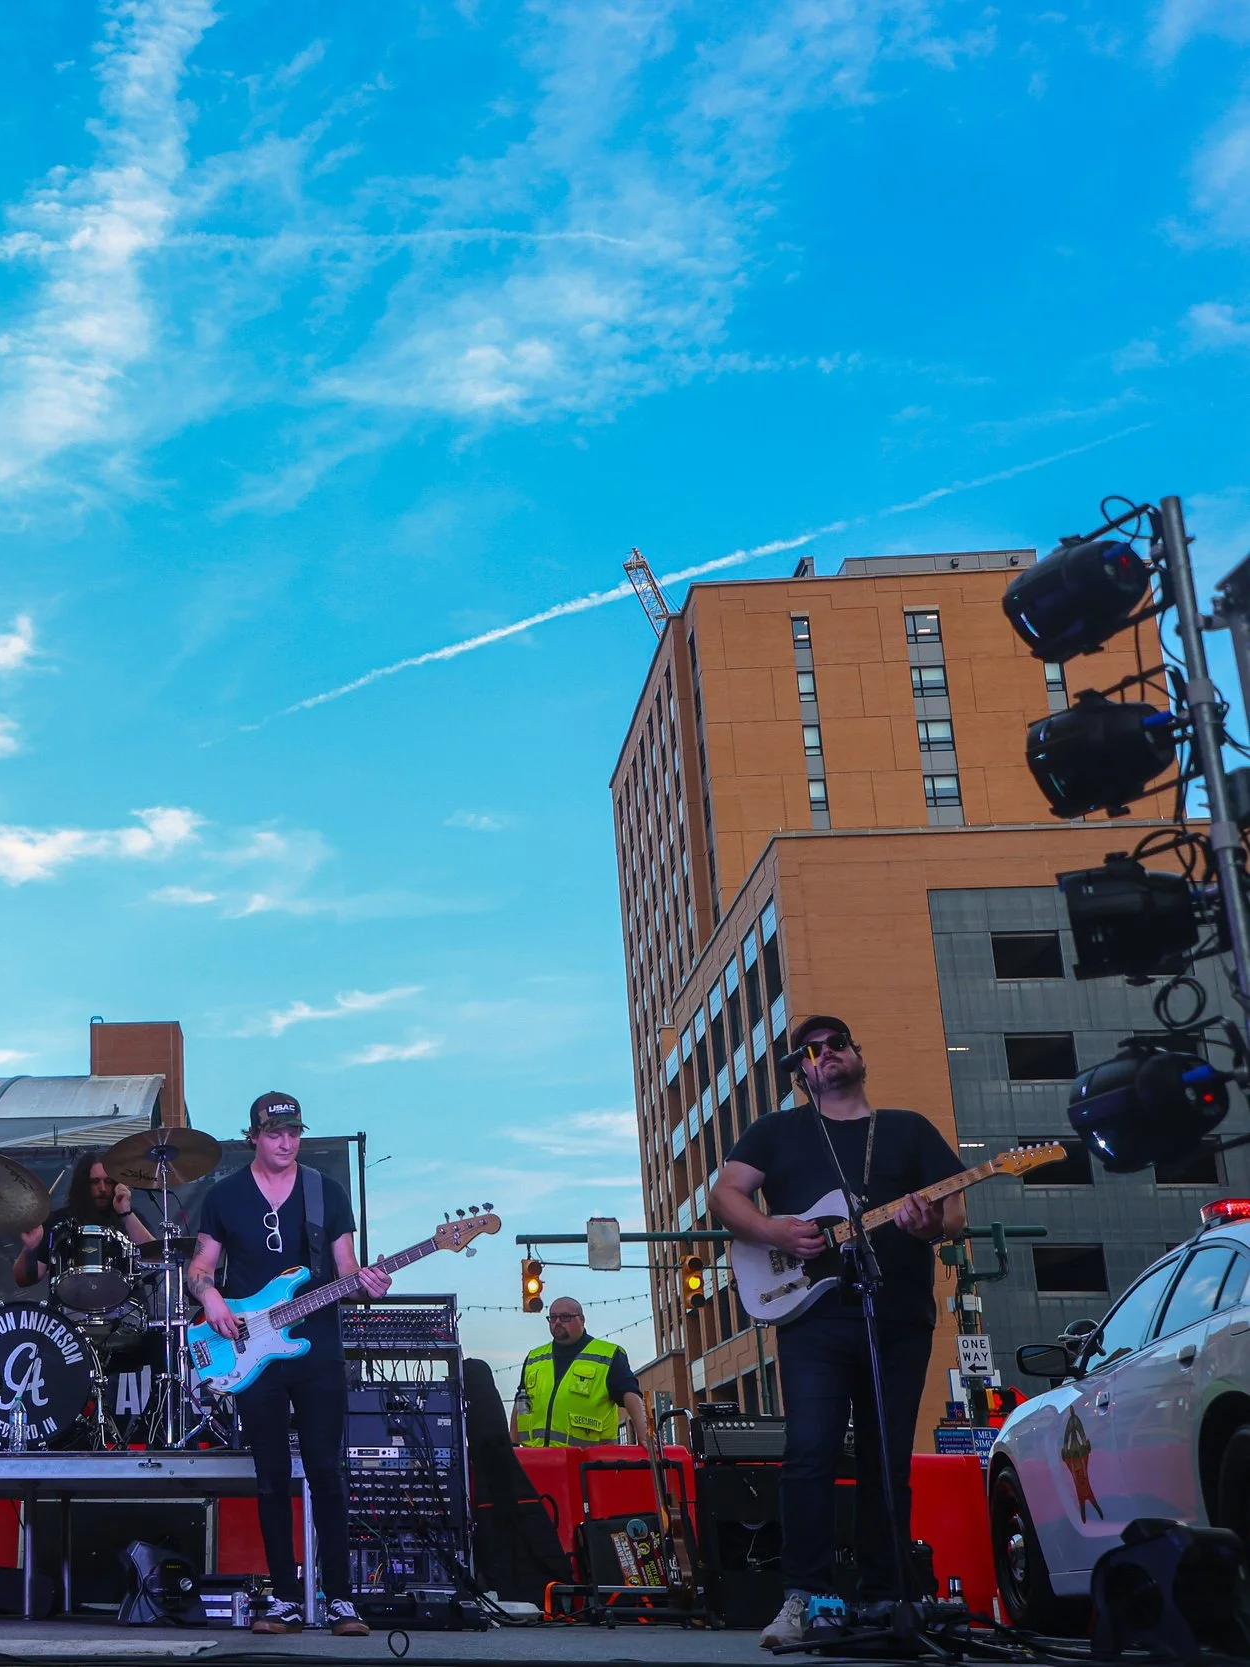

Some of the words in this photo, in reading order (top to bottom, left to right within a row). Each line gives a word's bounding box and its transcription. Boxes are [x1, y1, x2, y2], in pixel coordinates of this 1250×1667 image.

[268, 1104, 295, 1112] USAC
[962, 1339, 987, 1349] ONE
[962, 1352, 989, 1362] WAY
[42, 1417, 58, 1434] IN
[574, 1416, 601, 1427] SECURITY
[977, 1430, 995, 1439] MEL
[975, 1439, 994, 1448] SIMO
